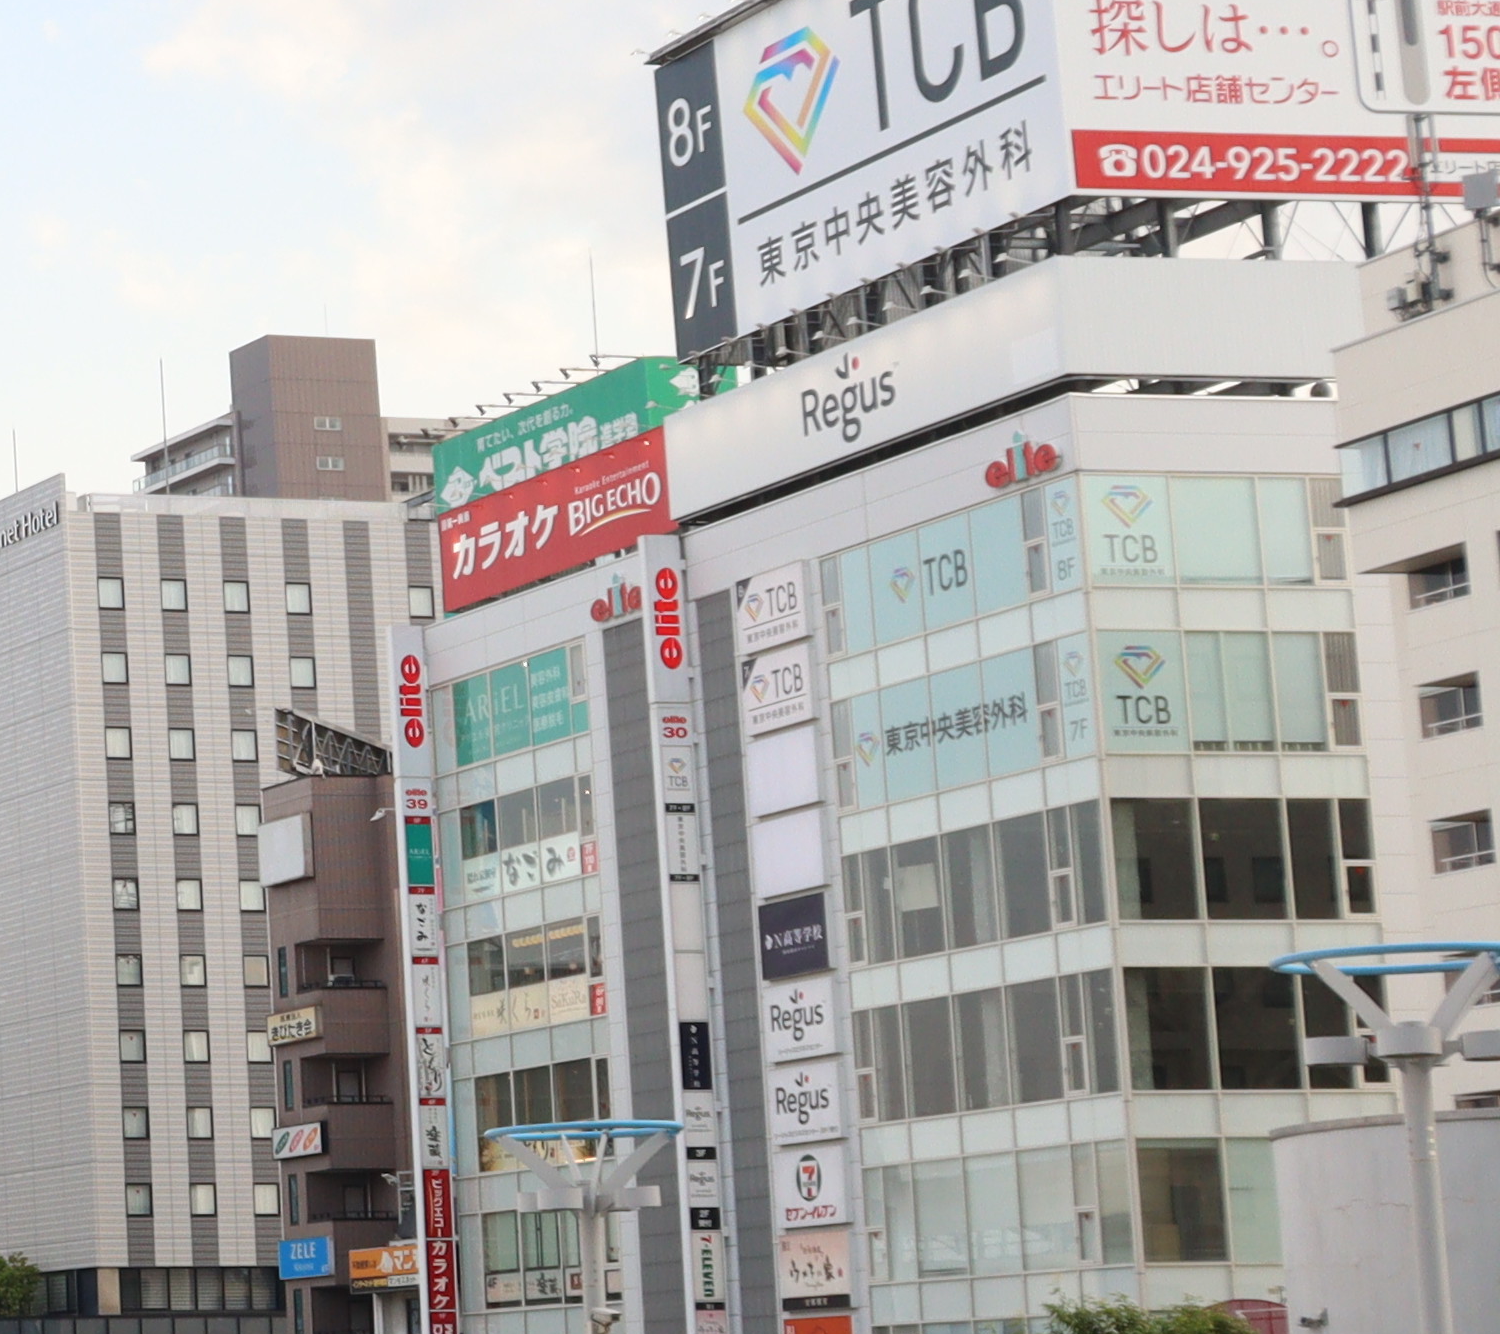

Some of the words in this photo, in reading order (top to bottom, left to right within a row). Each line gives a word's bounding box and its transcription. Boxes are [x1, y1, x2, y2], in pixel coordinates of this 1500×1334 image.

[1094, 74, 1340, 105] エリート店舗センター
[668, 98, 712, 166] 8F
[1141, 144, 1411, 184] 024-925-2222
[758, 120, 1032, 287] 東京中央美容外科
[679, 247, 725, 320] 7F
[803, 370, 896, 442] Regus
[22, 500, 60, 538] Hotel
[568, 494, 604, 537] BIG
[606, 472, 661, 512] ECHO
[453, 504, 559, 580] カラオケ
[1052, 518, 1074, 540] TCB
[1103, 534, 1158, 563] TCB
[923, 549, 968, 596] TCB
[1057, 557, 1076, 581] 8F
[765, 581, 798, 617] TCB
[771, 663, 804, 699] TCB
[1064, 678, 1088, 699] TCB
[885, 692, 1028, 756] 東京中央美容外科
[1116, 695, 1172, 724] TCB
[662, 727, 688, 739] 30
[1070, 717, 1089, 742] 7F
[668, 775, 688, 788] TCB
[406, 799, 428, 810] 39
[773, 923, 823, 949] N高等学校
[770, 1003, 824, 1041] Regus
[775, 1087, 830, 1125] Regus
[290, 1242, 316, 1260] ZELE
[431, 1241, 449, 1310] カラオケ
